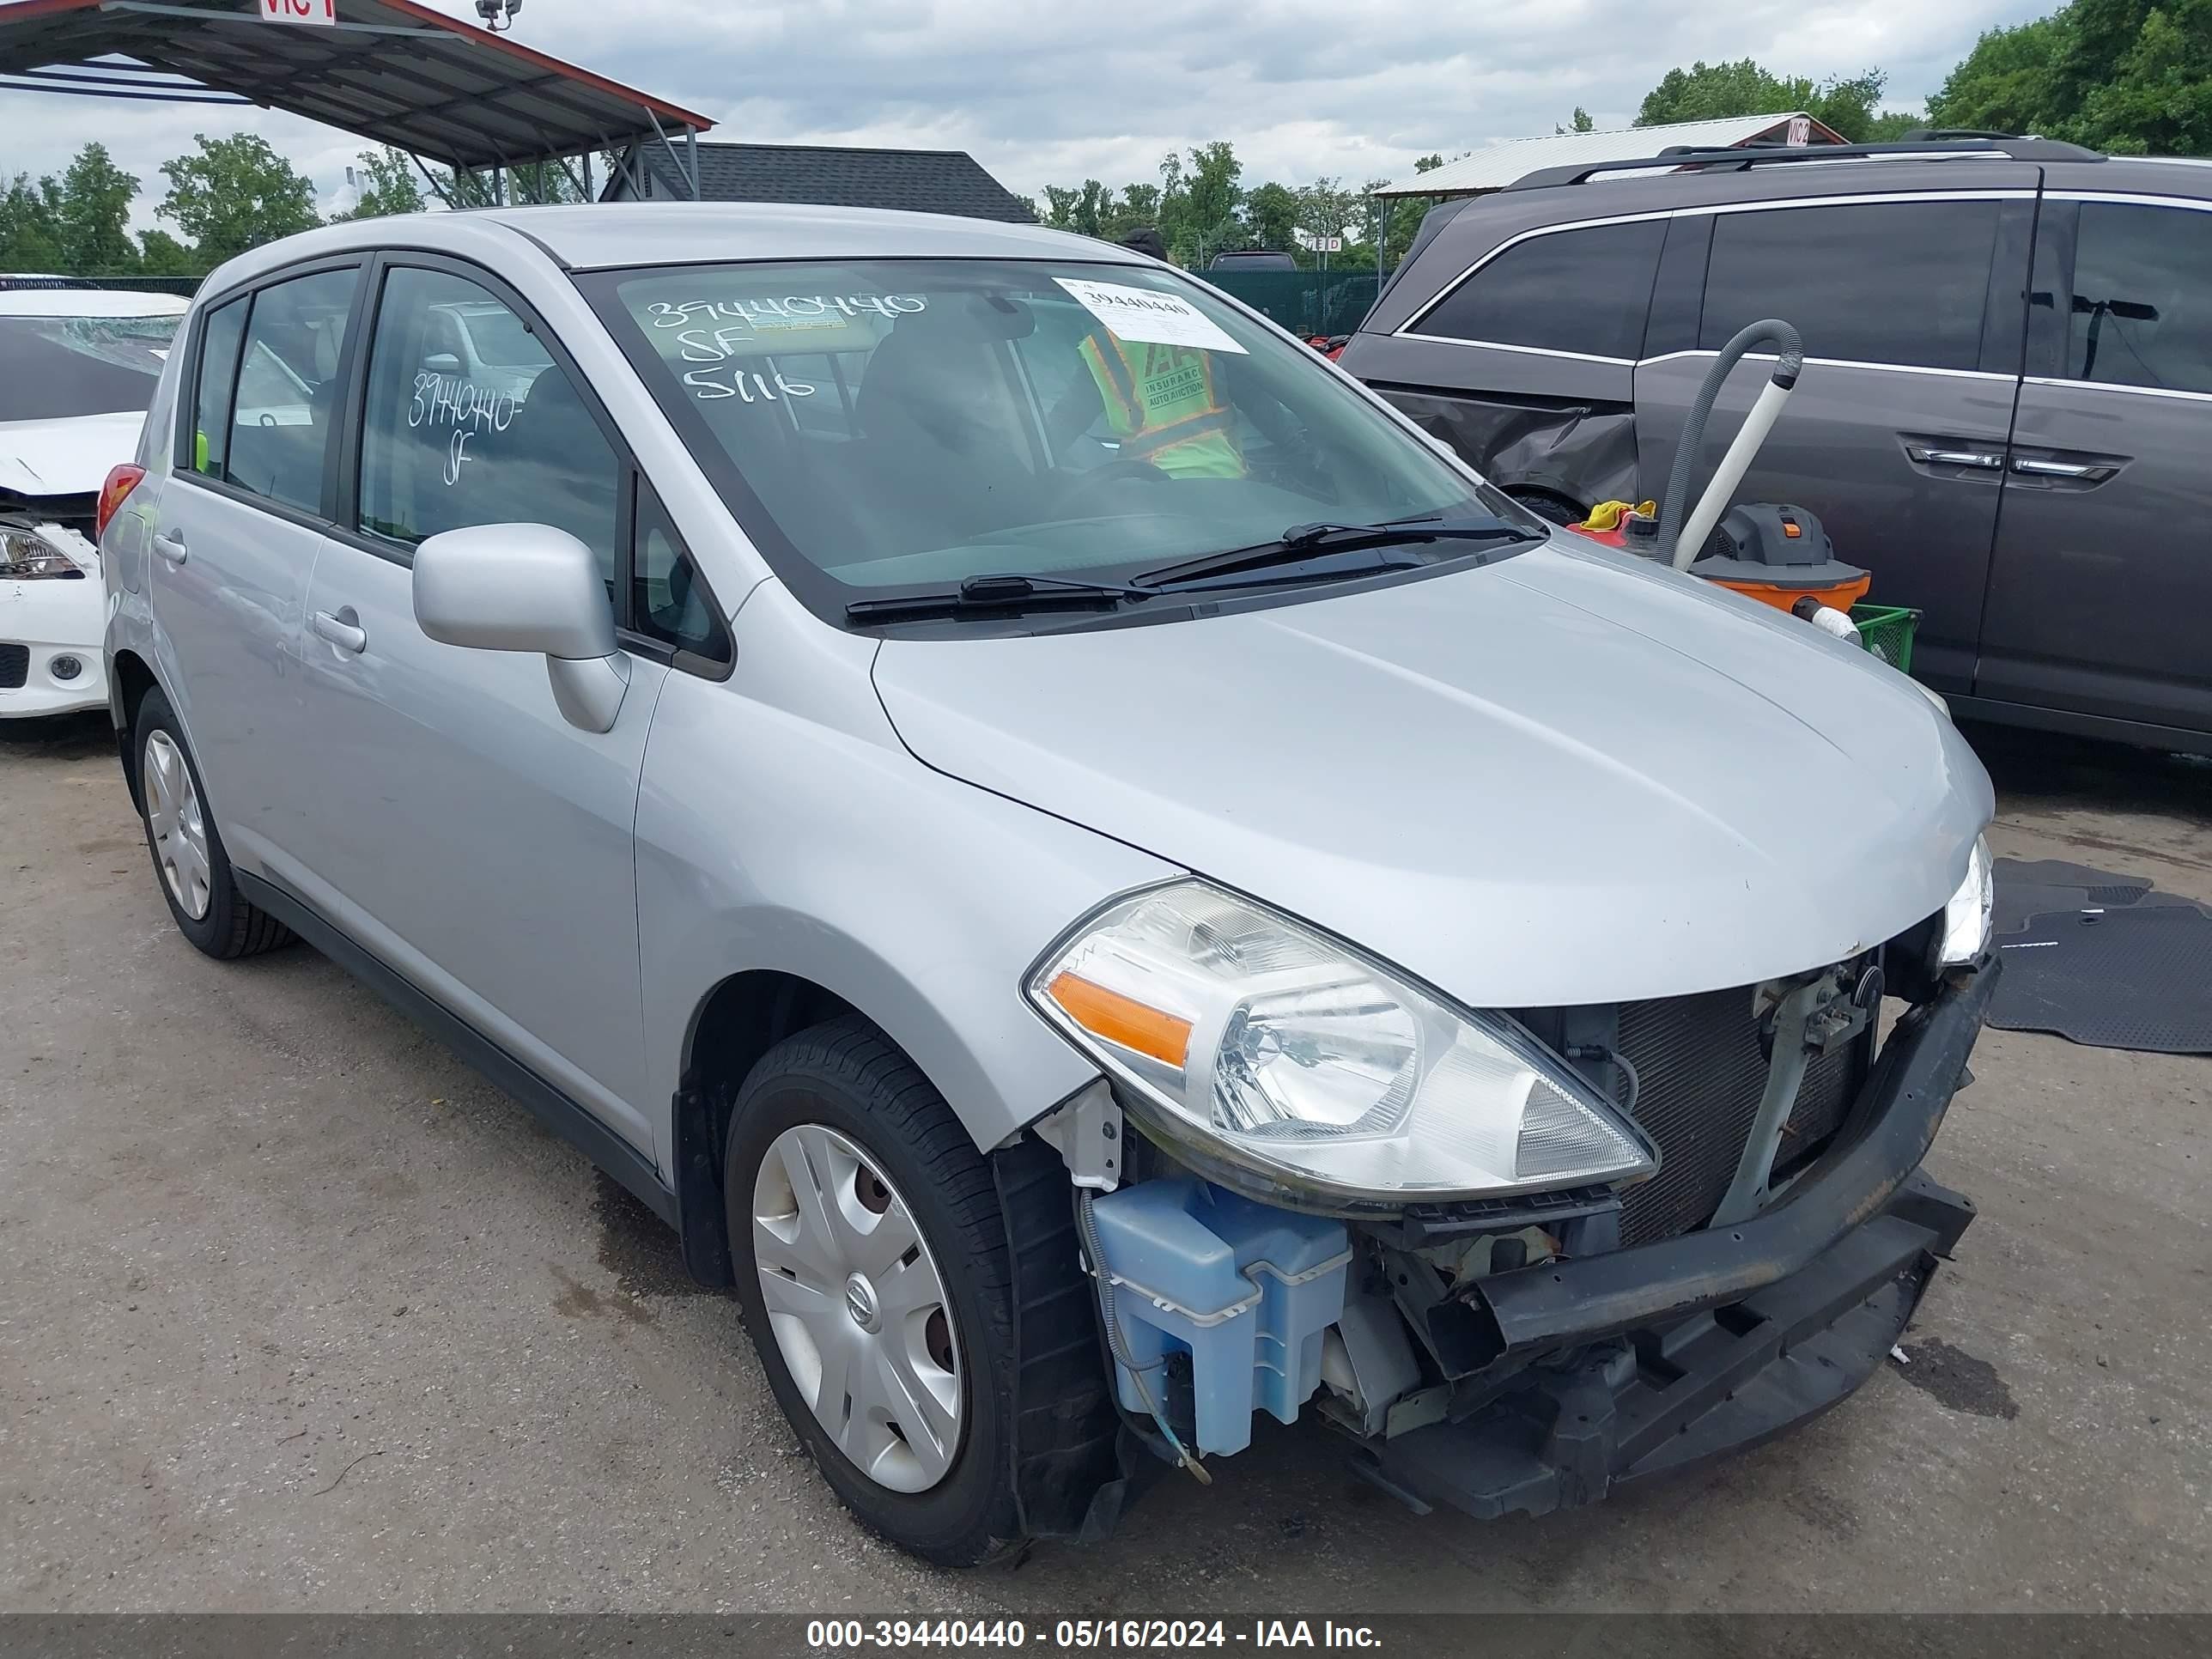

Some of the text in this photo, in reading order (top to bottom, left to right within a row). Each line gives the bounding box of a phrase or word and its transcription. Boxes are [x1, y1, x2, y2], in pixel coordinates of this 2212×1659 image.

[1790, 122, 1809, 143] VIC 2
[647, 295, 926, 328] 39440440
[1084, 291, 1190, 316] 39440440
[677, 326, 755, 362] SF
[1150, 393, 1170, 407] AUTO
